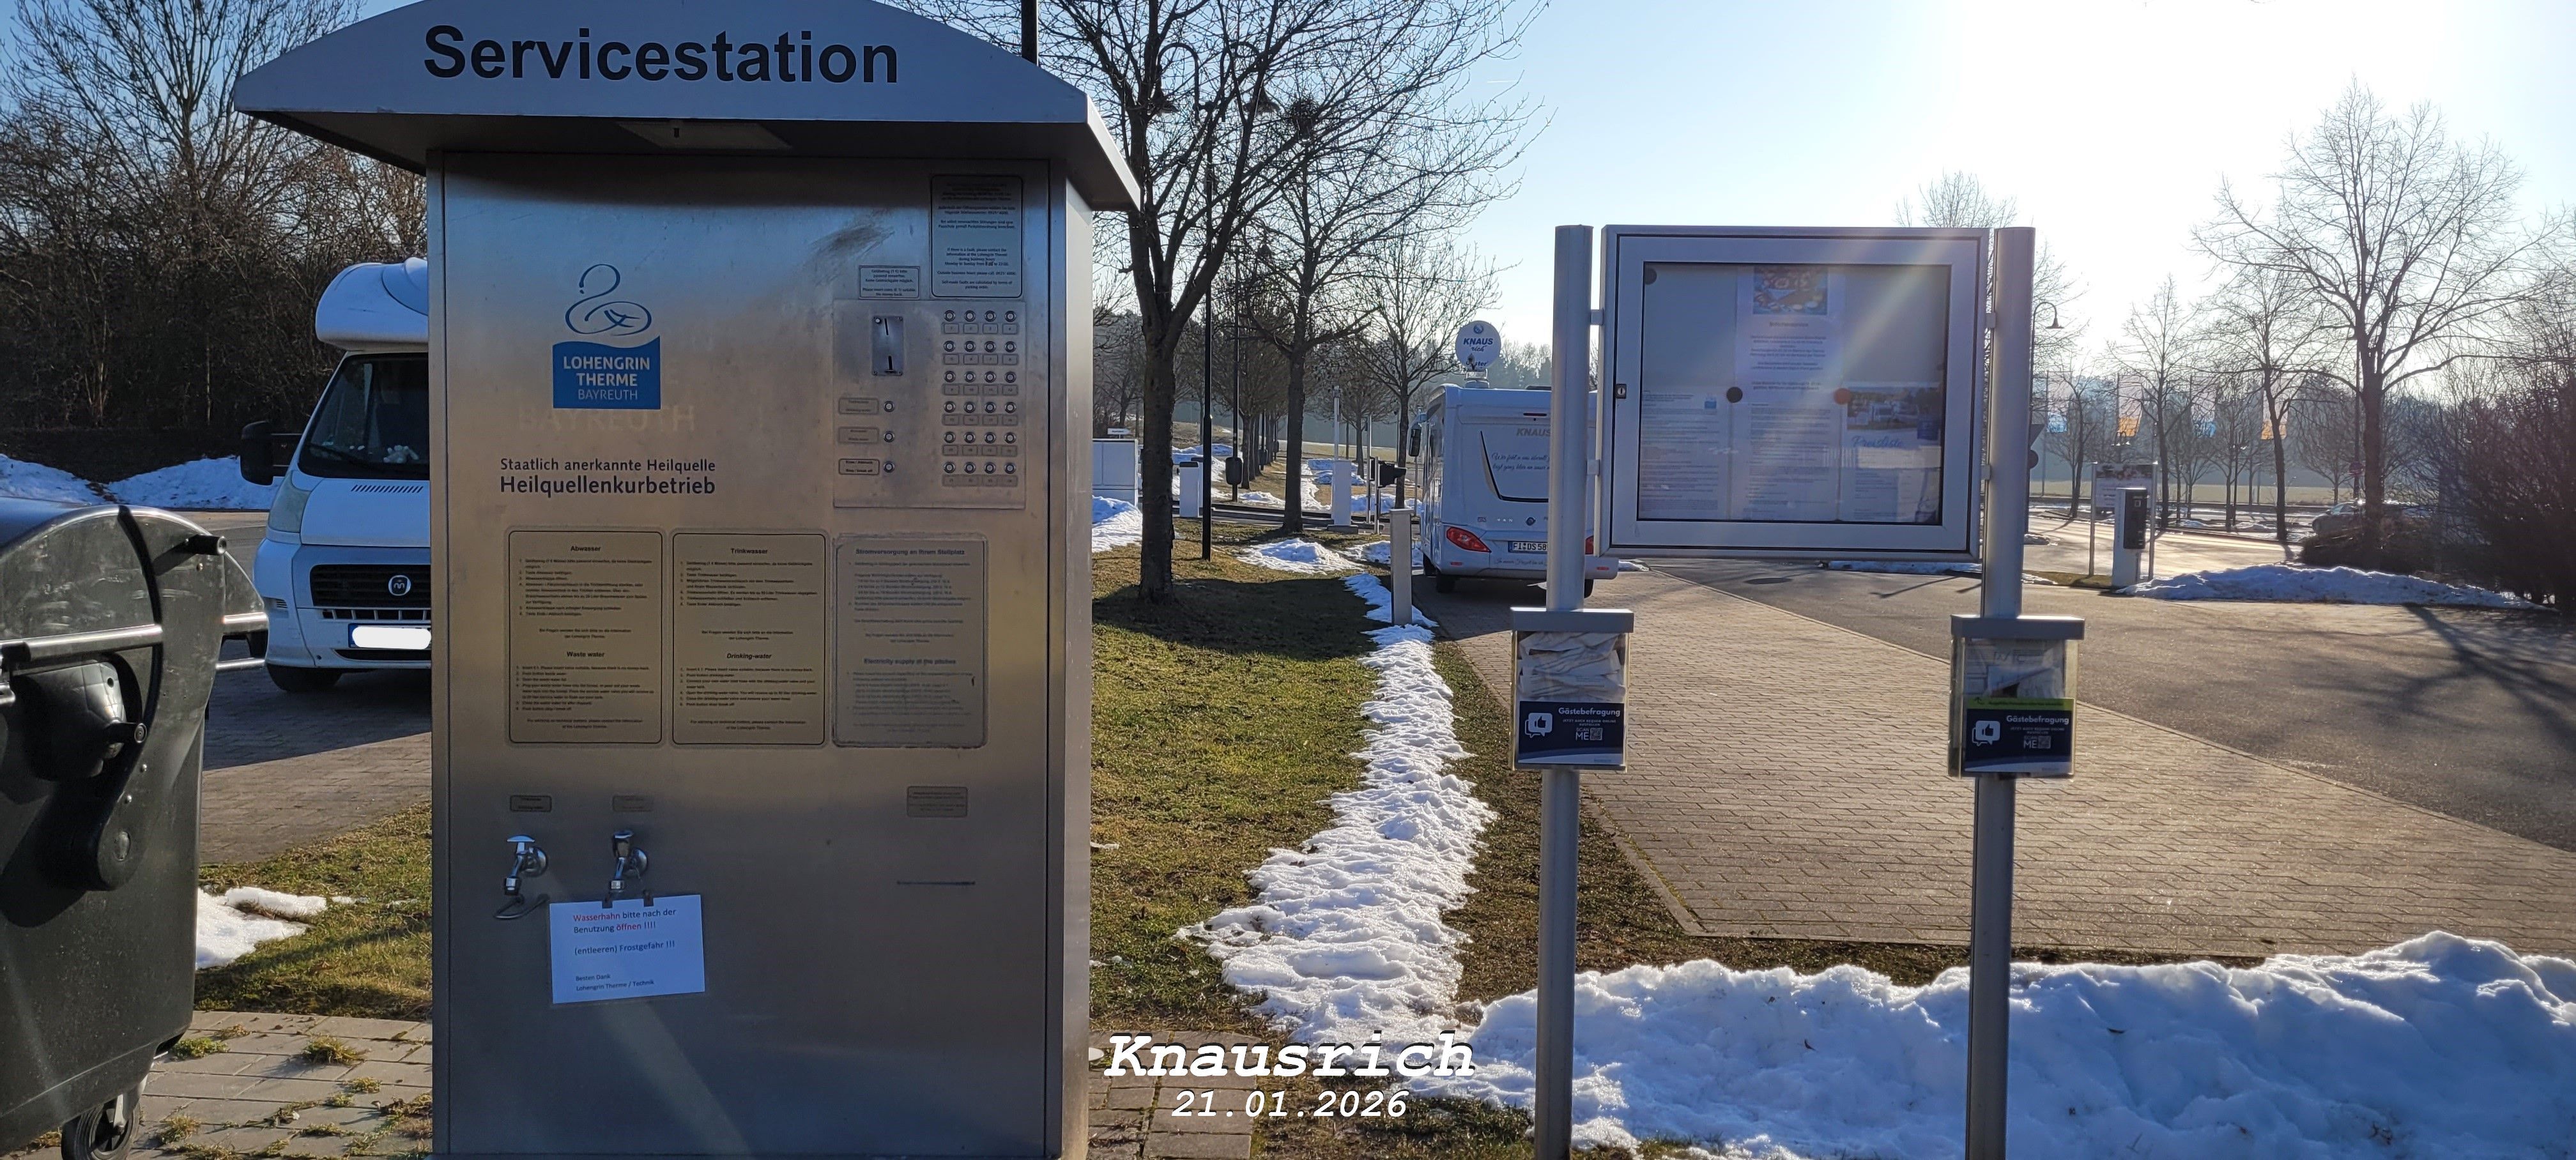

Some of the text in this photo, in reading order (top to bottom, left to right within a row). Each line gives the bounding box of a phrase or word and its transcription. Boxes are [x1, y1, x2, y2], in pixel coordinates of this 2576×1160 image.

[424, 24, 898, 84] Servicestation
[563, 356, 650, 370] LOHENGRIN
[576, 372, 638, 387] THERME
[578, 389, 638, 401] BAYREUTH
[501, 458, 716, 475] Staatlich anerkannte Heilquelle
[500, 476, 716, 498] Heilquellenkurbetrieb
[1558, 707, 1621, 717] Gästebefragung
[2006, 715, 2069, 725] Gästebefragung
[1575, 732, 1589, 741] ME
[2023, 740, 2037, 749] ME
[573, 912, 620, 922] Wasserhahn
[643, 909, 661, 917] nach
[574, 925, 615, 934] Benutzung
[575, 945, 618, 956] (entleeren)
[620, 942, 664, 952] Frostgefahr
